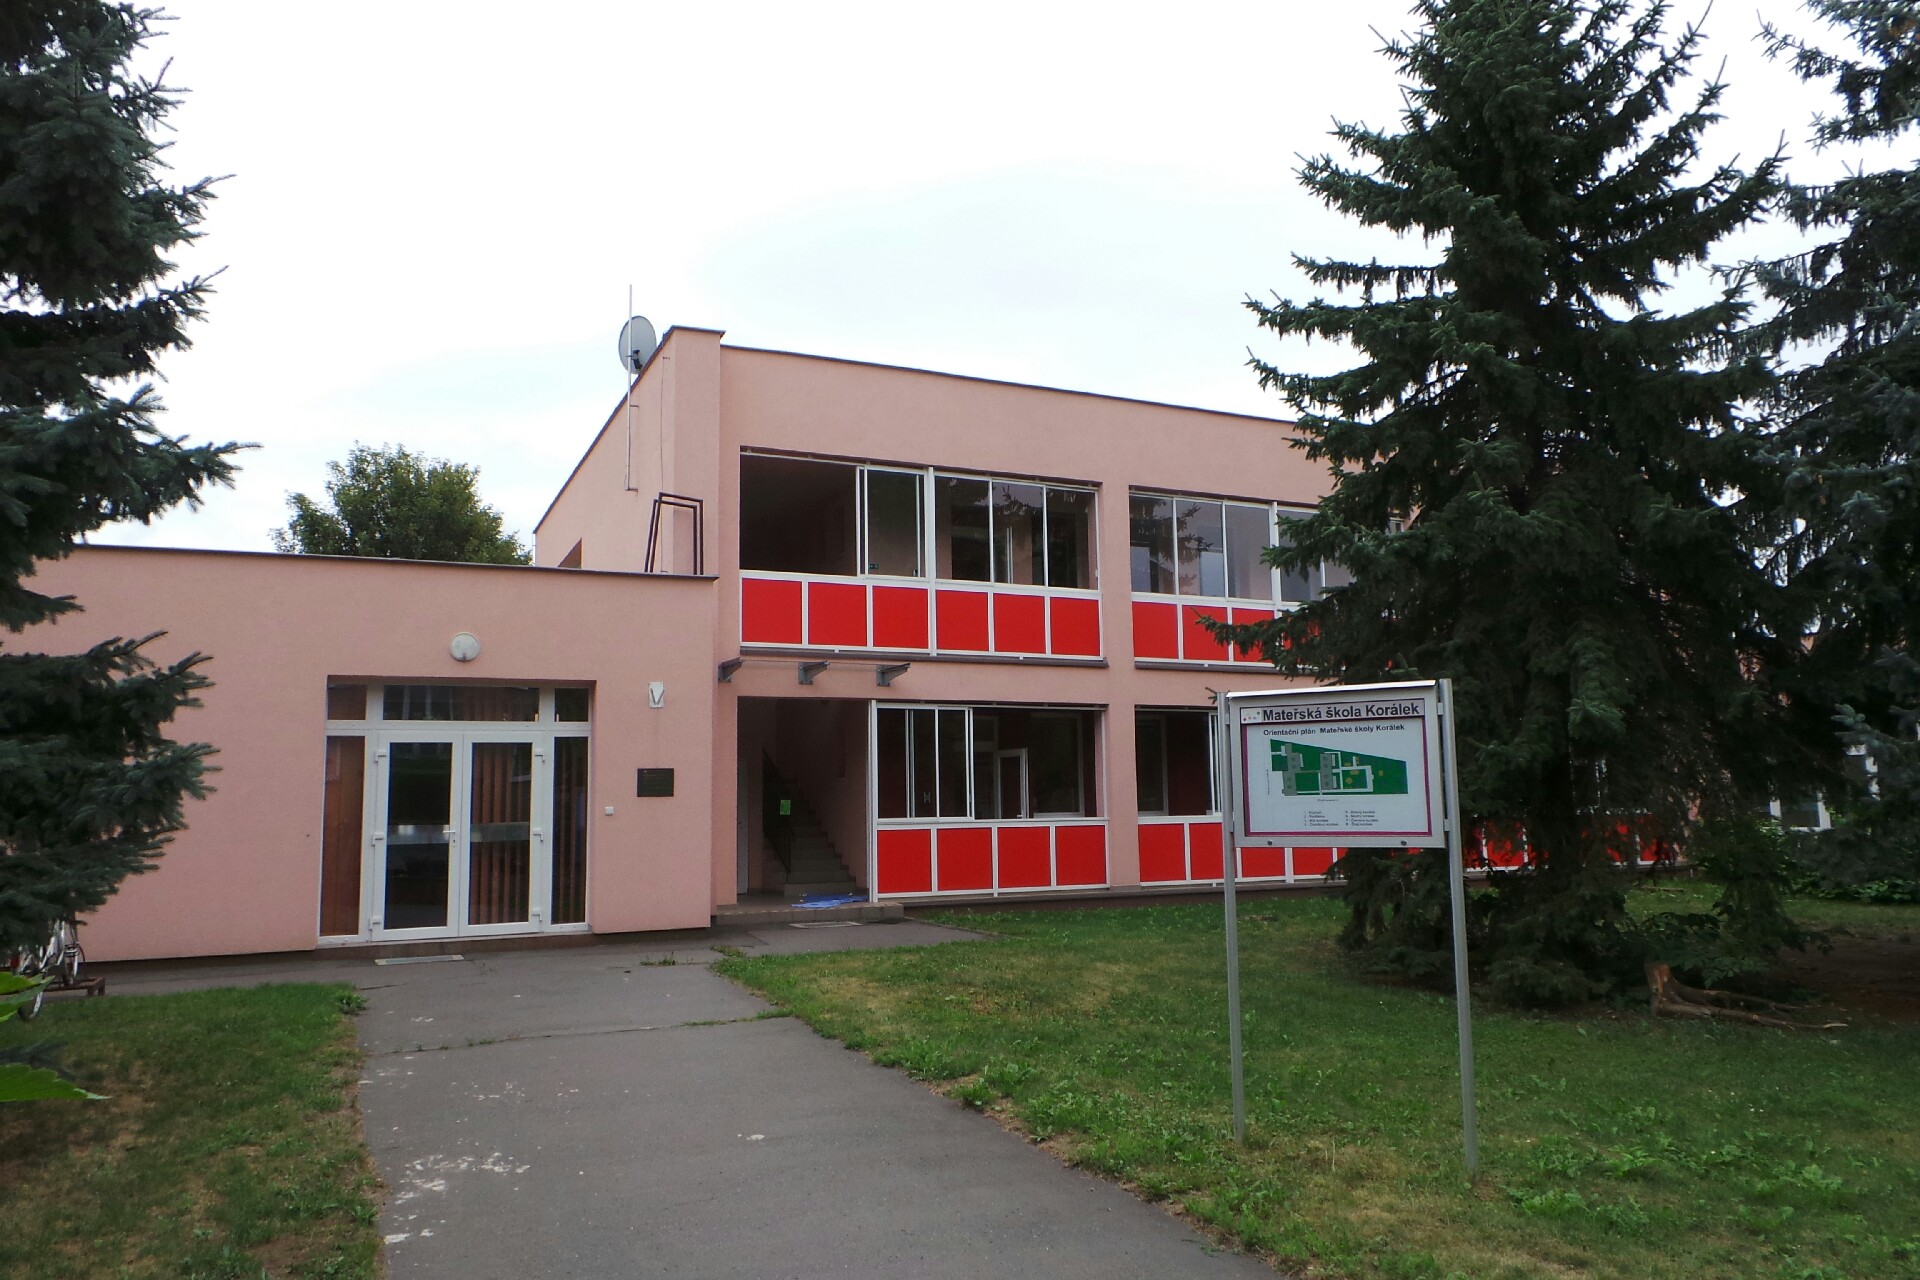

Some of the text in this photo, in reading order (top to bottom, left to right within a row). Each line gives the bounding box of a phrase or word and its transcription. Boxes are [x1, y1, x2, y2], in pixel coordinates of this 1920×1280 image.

[1263, 703, 1419, 721] Mateřská škola Korálek
[1263, 728, 1299, 736] Orientační
[1300, 727, 1316, 736] plán
[1354, 725, 1374, 734] školy
[1376, 724, 1405, 732] Korálek
